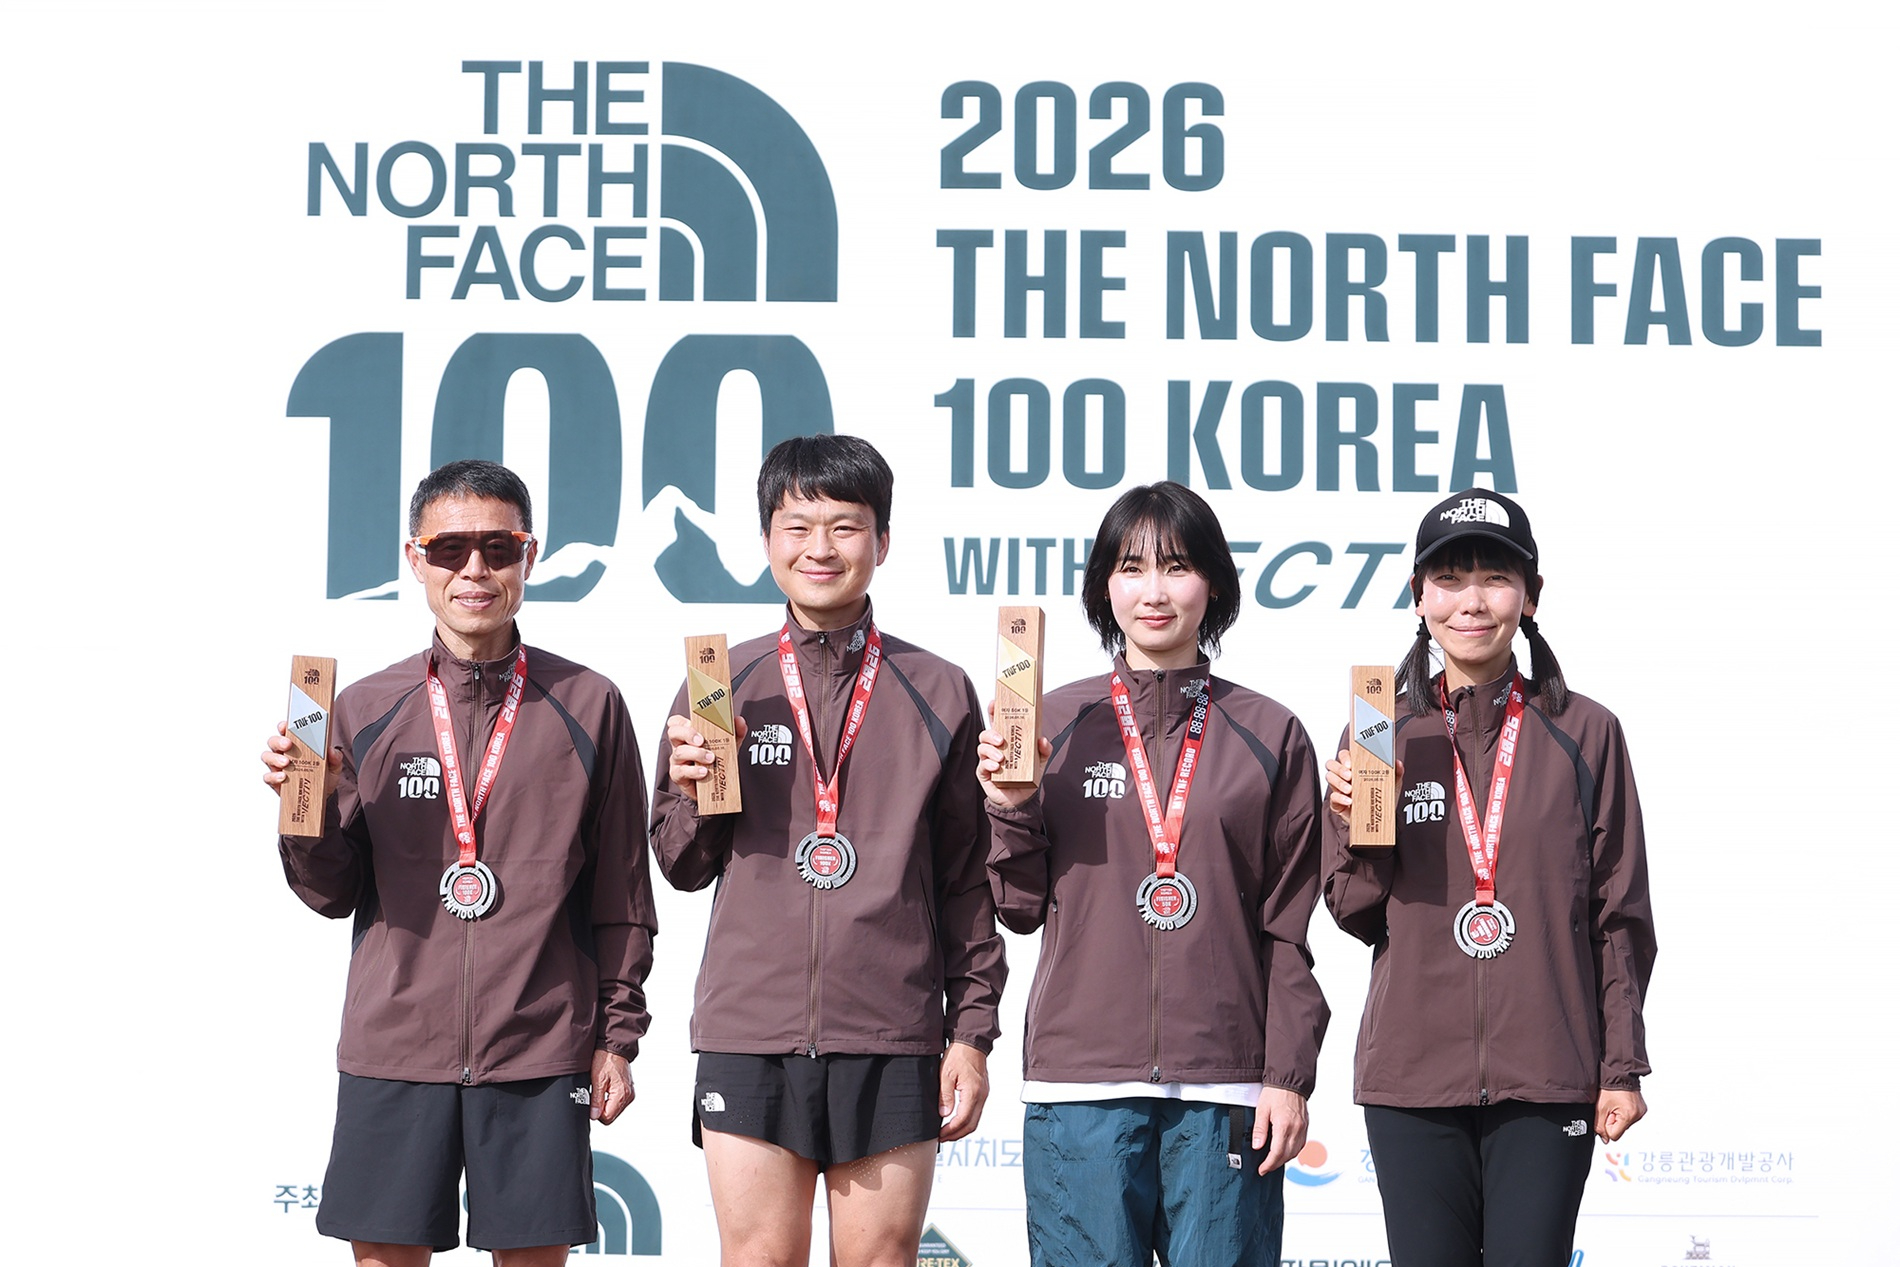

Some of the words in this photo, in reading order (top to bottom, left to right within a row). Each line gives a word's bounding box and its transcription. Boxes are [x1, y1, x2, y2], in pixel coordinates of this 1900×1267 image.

[462, 60, 649, 135] THE
[940, 80, 1225, 192] 2026
[307, 141, 648, 218] NORTH
[406, 224, 647, 303] FACE
[936, 228, 1126, 339] THE
[1165, 230, 1530, 345] NORTH
[1570, 234, 1823, 347] FACE
[933, 377, 1127, 490] 100
[1167, 379, 1519, 494] KOREA
[286, 332, 836, 604] 100
[1440, 505, 1486, 521] NORTH
[1459, 498, 1486, 509] THE
[1451, 515, 1486, 524] FACE
[944, 537, 1094, 596] WITH
[1011, 626, 1026, 634] 100
[700, 655, 715, 664] 100
[859, 643, 880, 692] 2026
[304, 676, 319, 685] 100
[781, 653, 802, 698] 2026
[501, 672, 524, 724] 2026
[1366, 685, 1381, 694] 100
[1114, 694, 1138, 738] 2026
[751, 730, 778, 738] NORTH
[1498, 715, 1519, 767] 2026
[486, 754, 498, 768] 100
[749, 744, 791, 765] 100
[1179, 747, 1196, 778] RECORD
[398, 776, 439, 799] 100
[448, 769, 459, 787] FACE
[481, 768, 493, 787] FACE
[1175, 777, 1188, 795] TNF
[1416, 782, 1430, 790] THE
[1083, 778, 1125, 799] 100
[1405, 787, 1430, 798] NORTH
[1412, 794, 1430, 802] FACE
[451, 788, 464, 813] NORTH
[1145, 798, 1161, 824] NORTH
[1172, 795, 1183, 810] MY
[1490, 800, 1501, 814] 100
[456, 813, 466, 828] THE
[1403, 800, 1444, 824] 100
[1153, 824, 1164, 838] THE
[1486, 814, 1499, 833] FACE
[1467, 823, 1481, 850] NORTH
[1473, 850, 1484, 865] THE
[797, 863, 832, 889] TNF100
[441, 896, 474, 920] TNF100
[1138, 905, 1175, 931] TNF100
[1477, 935, 1513, 959] TNF100
[1638, 1151, 1794, 1172] 강릉관광개발공사
[1638, 1175, 1690, 1184] Gangneung
[1693, 1175, 1728, 1183] Tourism
[917, 1257, 960, 1267] RE-TEX
